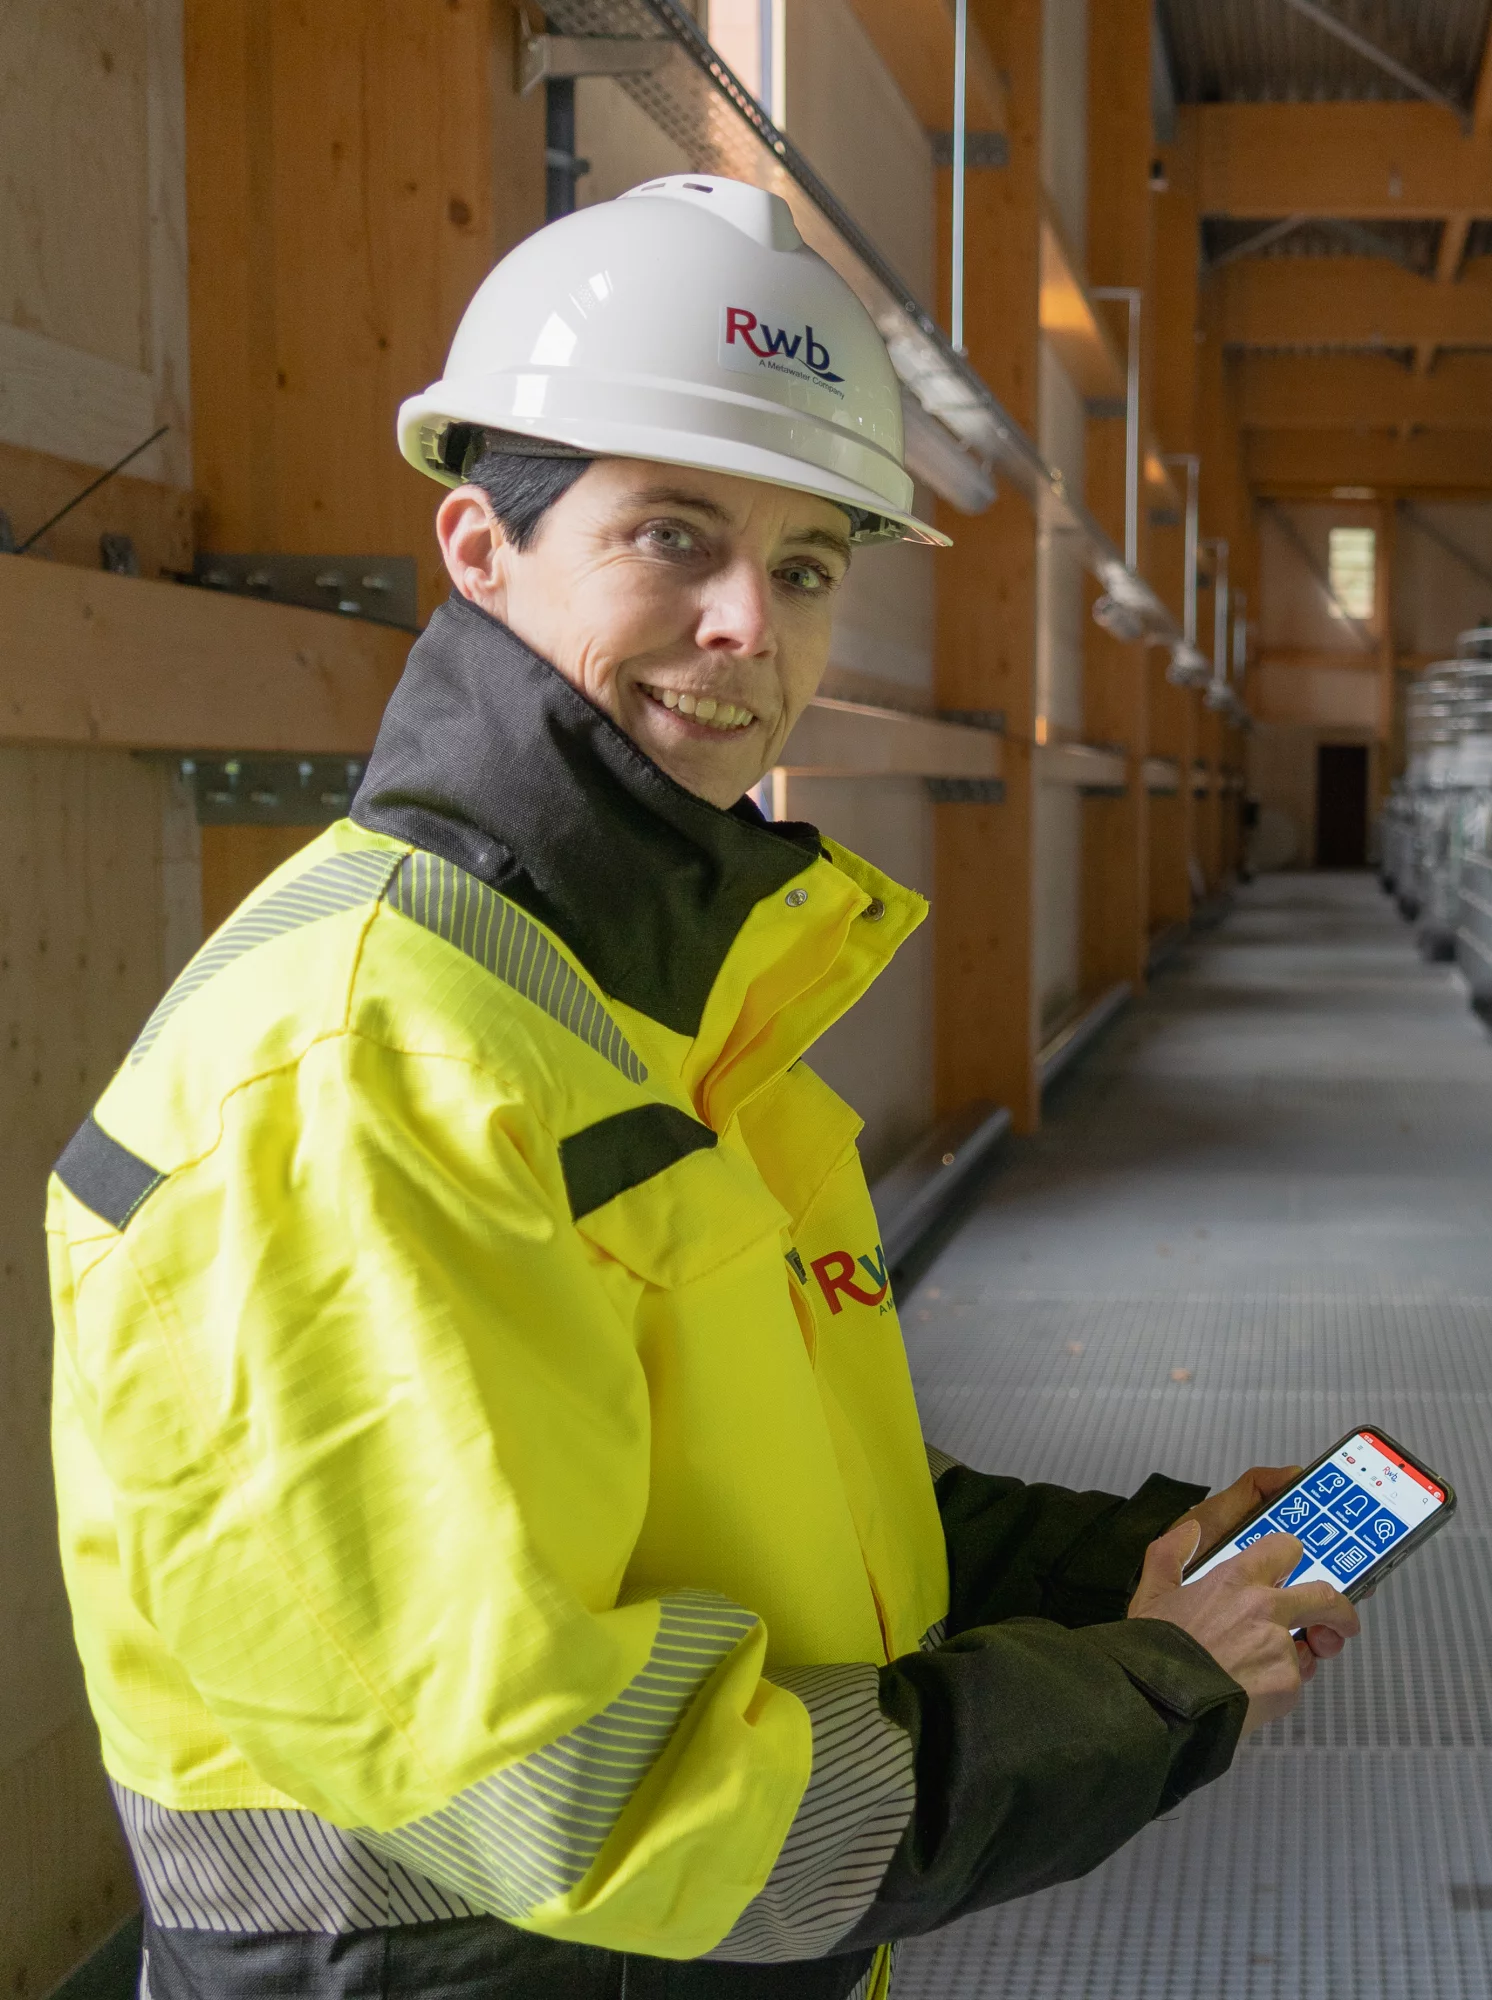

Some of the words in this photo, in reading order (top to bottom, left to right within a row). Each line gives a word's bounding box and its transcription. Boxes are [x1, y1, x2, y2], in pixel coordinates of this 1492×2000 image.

[726, 306, 830, 372] Rwb
[768, 361, 811, 381] Metawater
[812, 377, 845, 400] Company
